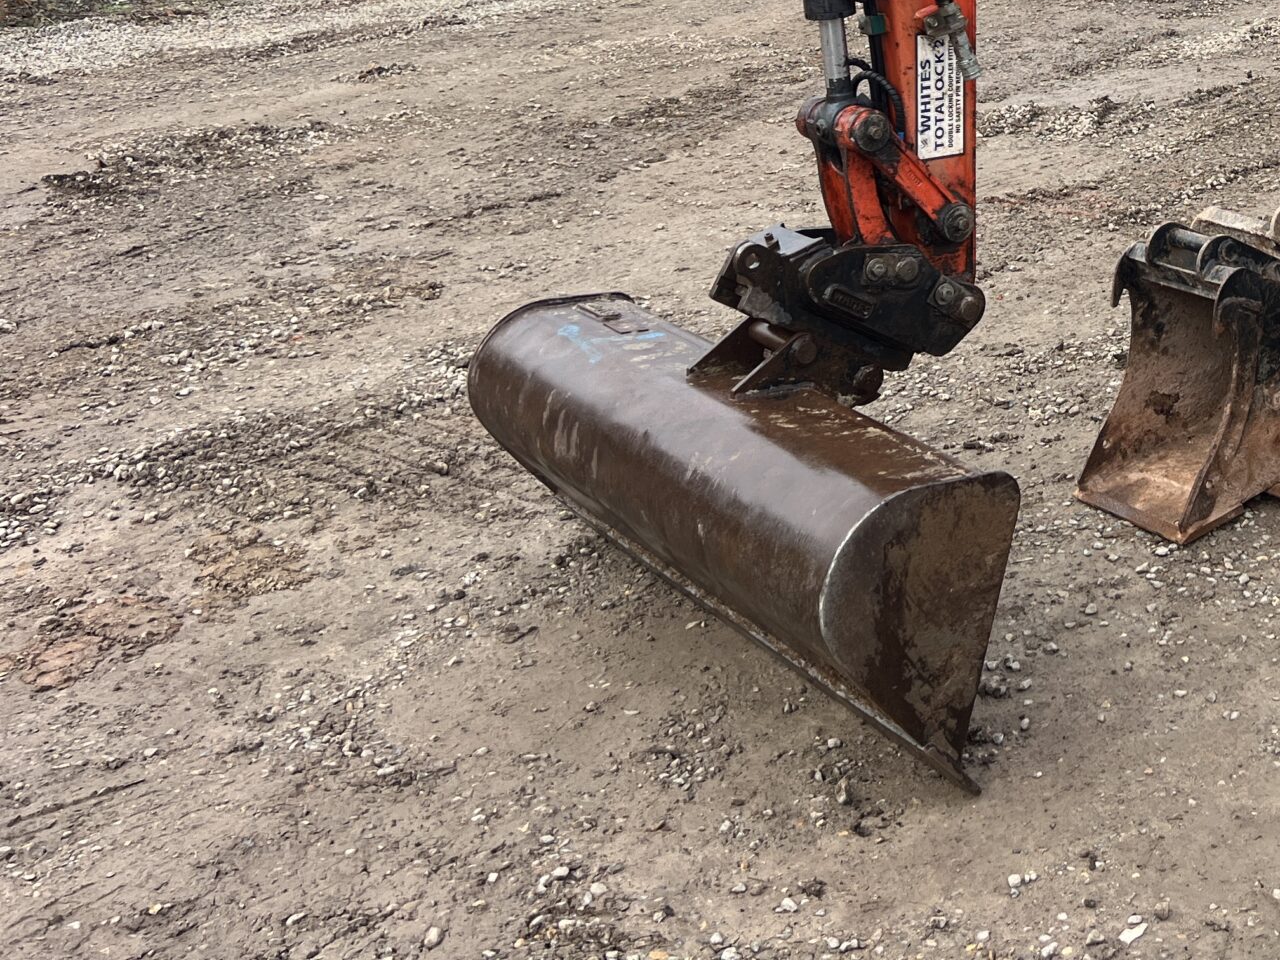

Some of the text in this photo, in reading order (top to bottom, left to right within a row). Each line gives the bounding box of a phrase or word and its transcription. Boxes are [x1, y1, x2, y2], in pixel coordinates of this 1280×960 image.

[920, 59, 931, 135] WHITES
[934, 52, 945, 151] TOTALOCK
[955, 124, 961, 134] NO
